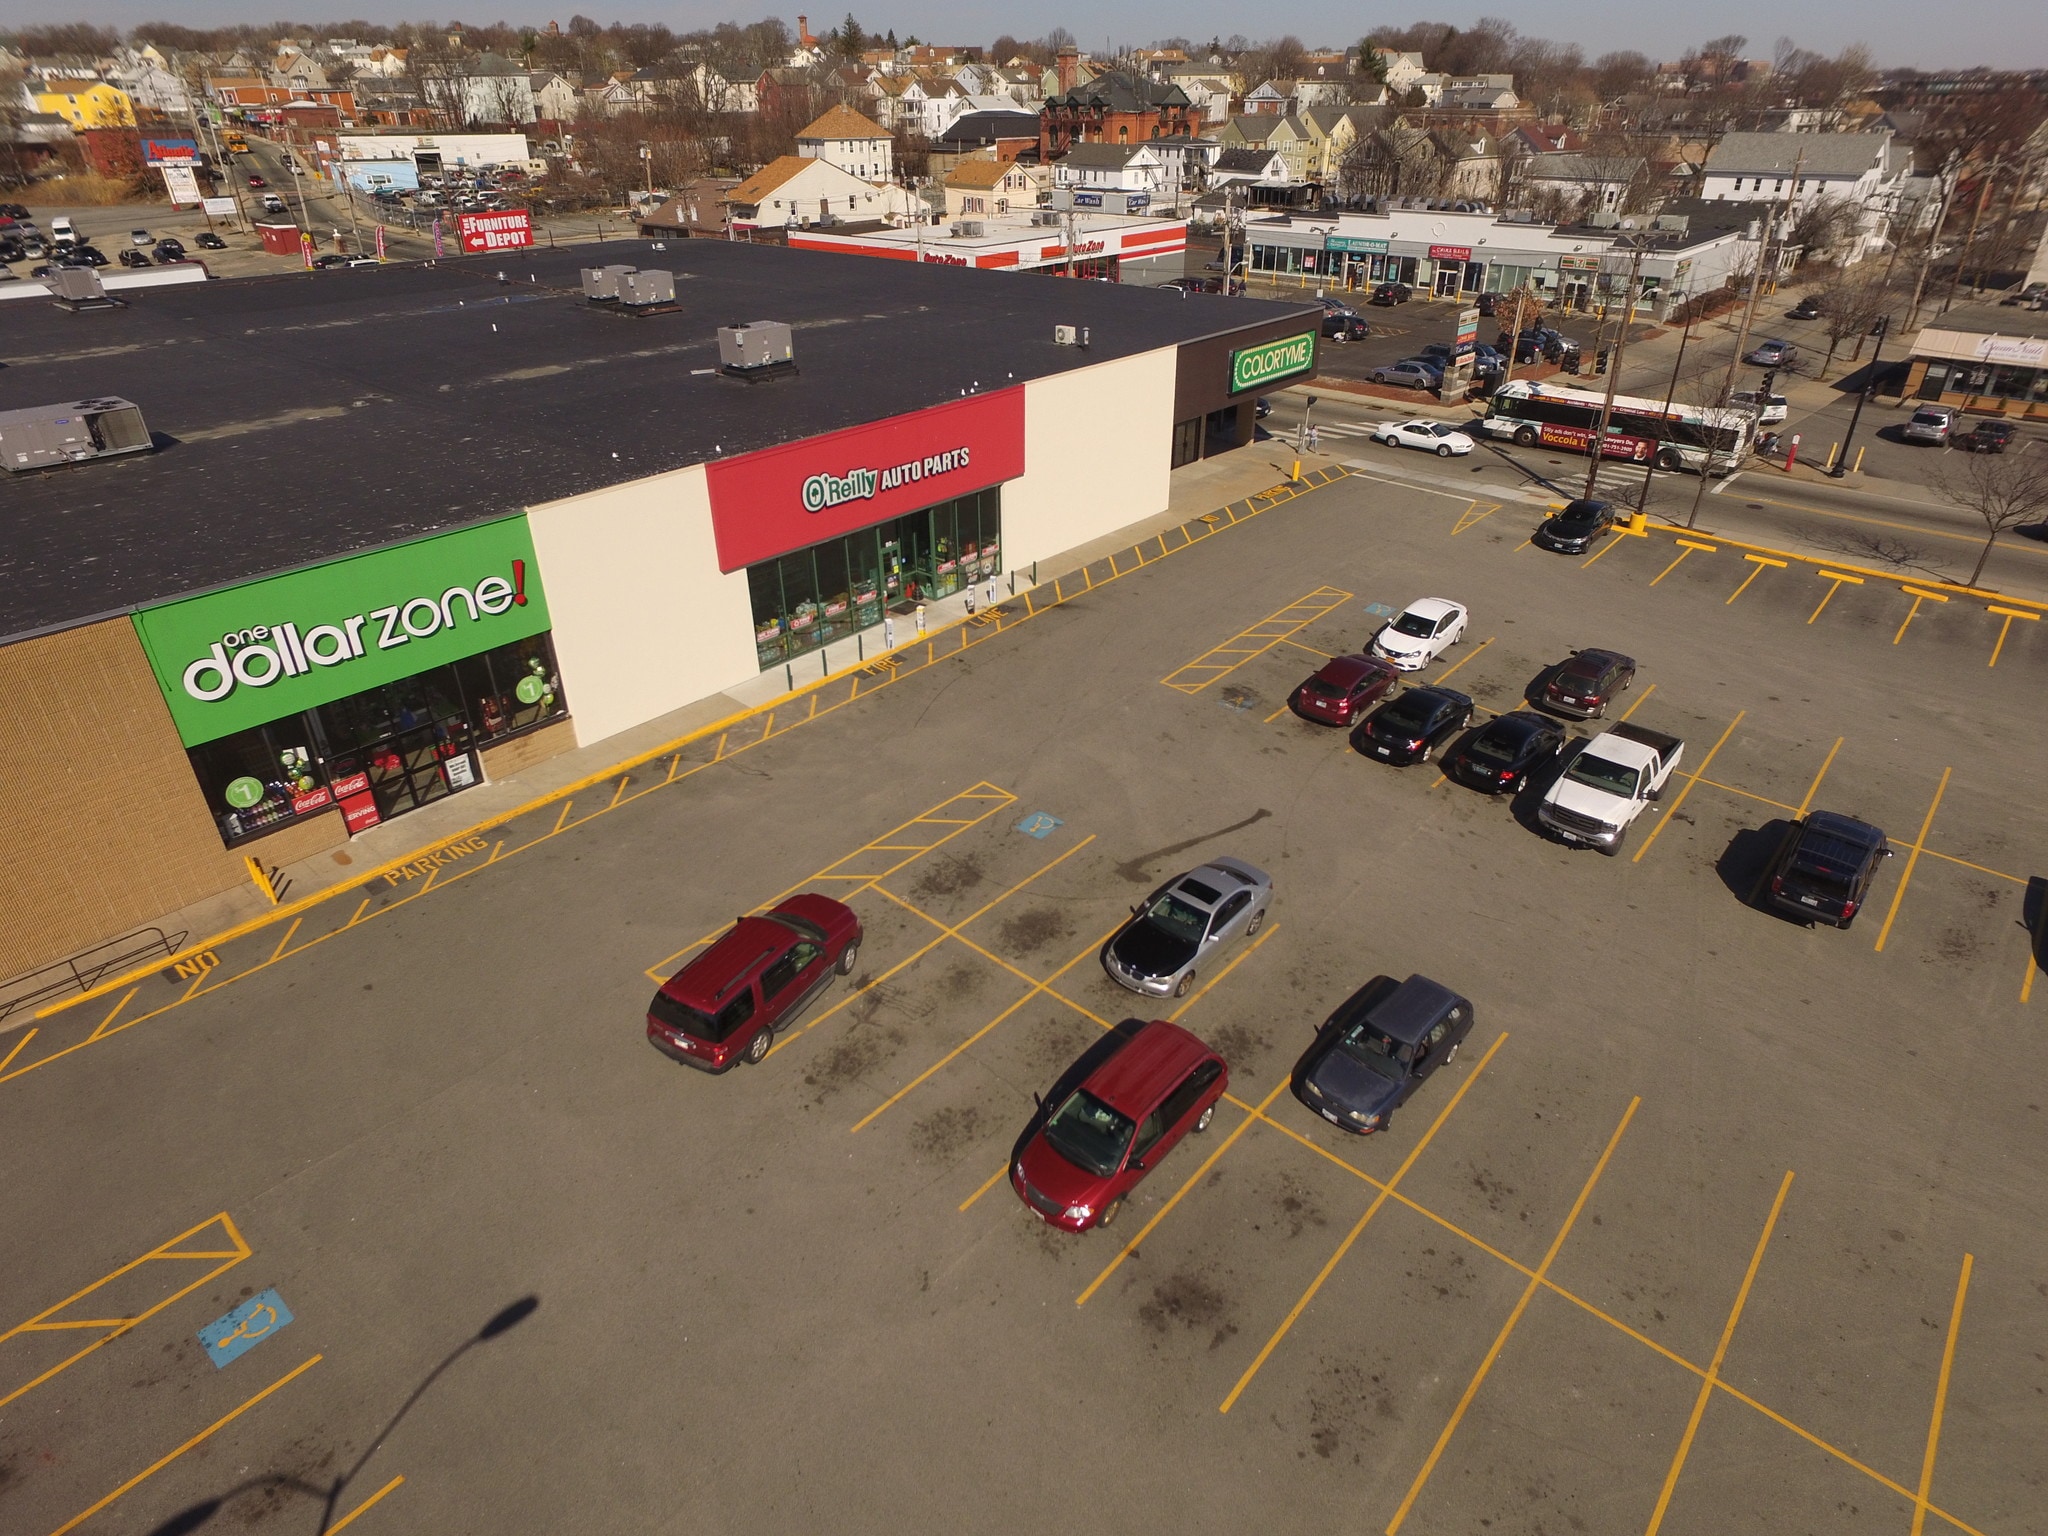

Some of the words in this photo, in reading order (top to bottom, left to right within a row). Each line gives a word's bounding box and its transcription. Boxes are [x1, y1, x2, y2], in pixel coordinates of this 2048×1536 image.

[469, 215, 529, 233] FURNITURE
[485, 231, 526, 248] DEPOT
[1242, 341, 1307, 379] COLORTYME
[1543, 432, 1578, 446] Voccola
[1604, 436, 1625, 445] Lawyers
[802, 468, 879, 512] O'Reilly
[881, 461, 911, 491] AUTO
[923, 448, 970, 478] PARTS
[968, 607, 1009, 628] LANE
[223, 625, 269, 648] one
[182, 615, 365, 701] dollar
[382, 835, 489, 887] PARKING
[173, 950, 222, 980] NO
